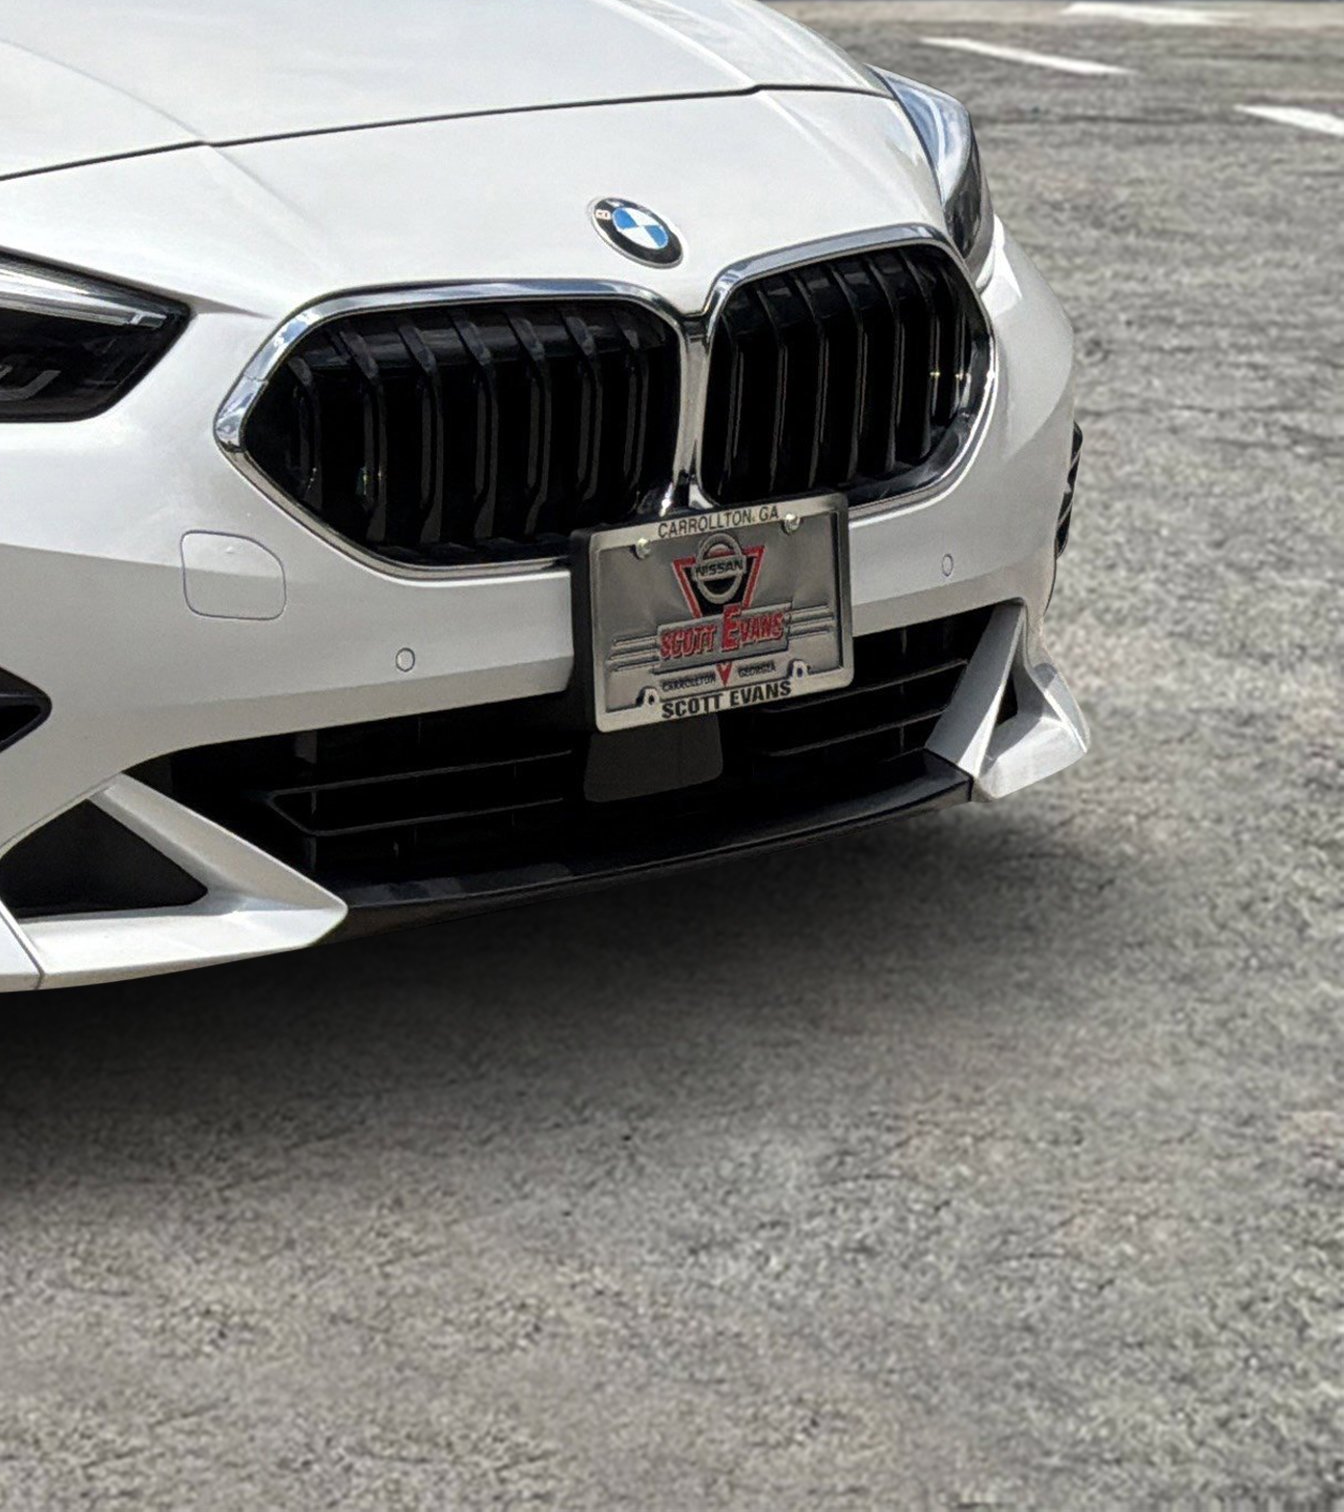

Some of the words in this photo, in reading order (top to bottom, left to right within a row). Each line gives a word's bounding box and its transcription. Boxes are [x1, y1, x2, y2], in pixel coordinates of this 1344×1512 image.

[758, 505, 779, 522] GA
[695, 558, 744, 576] NISSAN
[660, 624, 717, 660] SCOTT
[661, 692, 723, 719] SCOTT
[730, 680, 792, 707] EVANS
